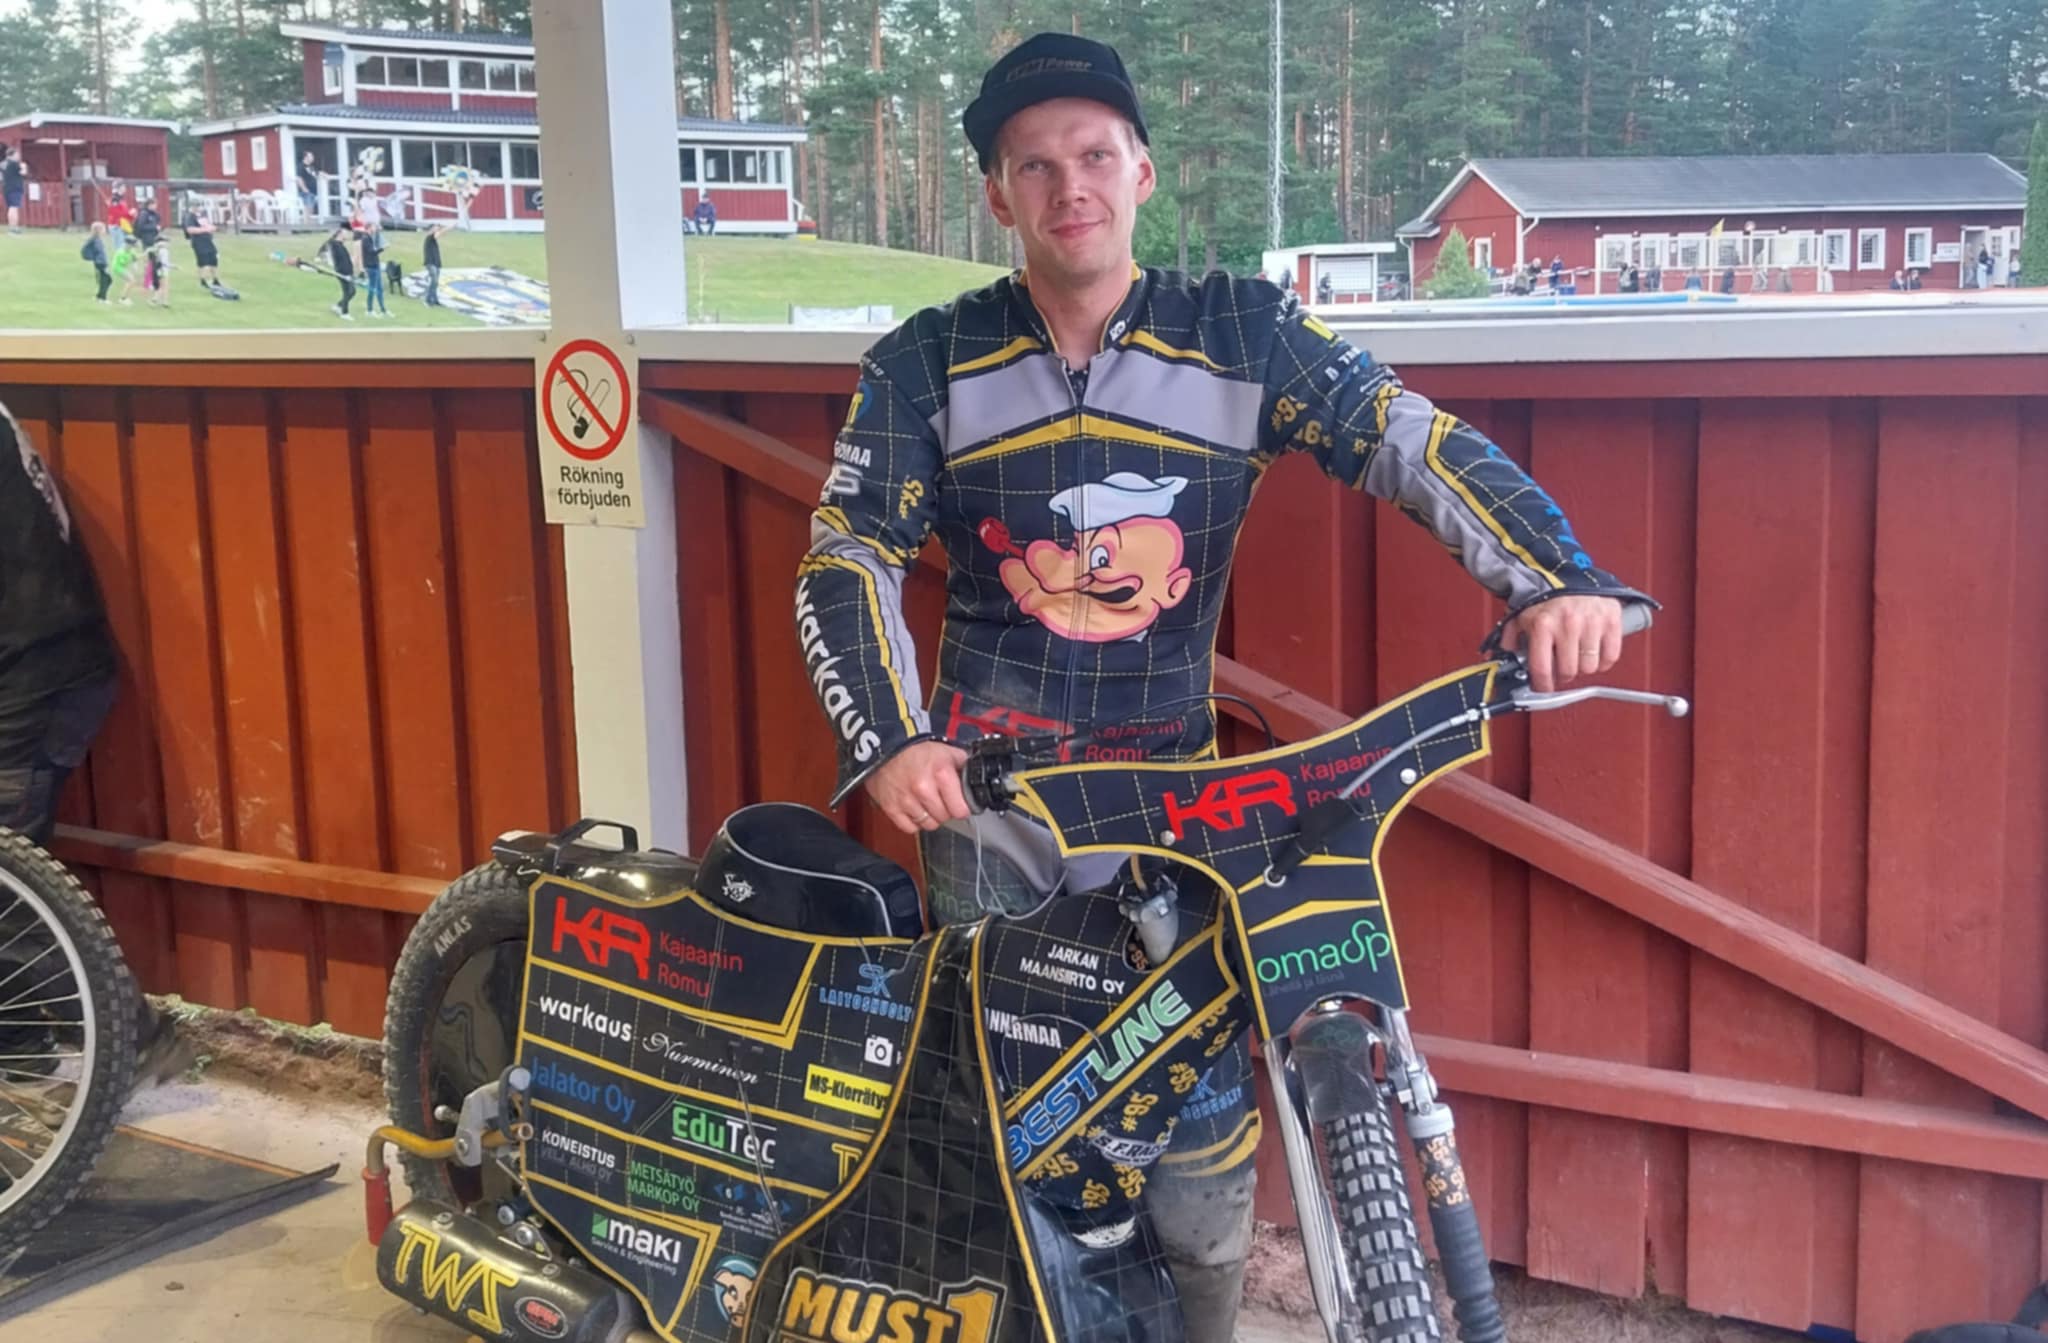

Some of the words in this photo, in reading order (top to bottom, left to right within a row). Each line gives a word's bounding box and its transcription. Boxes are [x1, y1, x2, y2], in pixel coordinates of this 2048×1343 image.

[560, 465, 624, 489] Rökning
[557, 487, 632, 510] förbjuden
[795, 577, 881, 762] warkaus
[1306, 783, 1372, 808] Rou
[659, 931, 744, 972] Kajaanin
[1047, 943, 1100, 970] JARKAN
[657, 962, 711, 998] Romu
[1019, 957, 1097, 991] MAANSIRTO
[1102, 979, 1126, 994] OY
[539, 995, 633, 1042] warkaus
[1007, 978, 1192, 1169] BESTLINE
[604, 1083, 636, 1124] Oy
[542, 1129, 616, 1168] KONEISTUS
[672, 1106, 776, 1164] EduTec
[629, 1160, 696, 1195] METSÄTYÖ
[682, 1194, 701, 1213] OY
